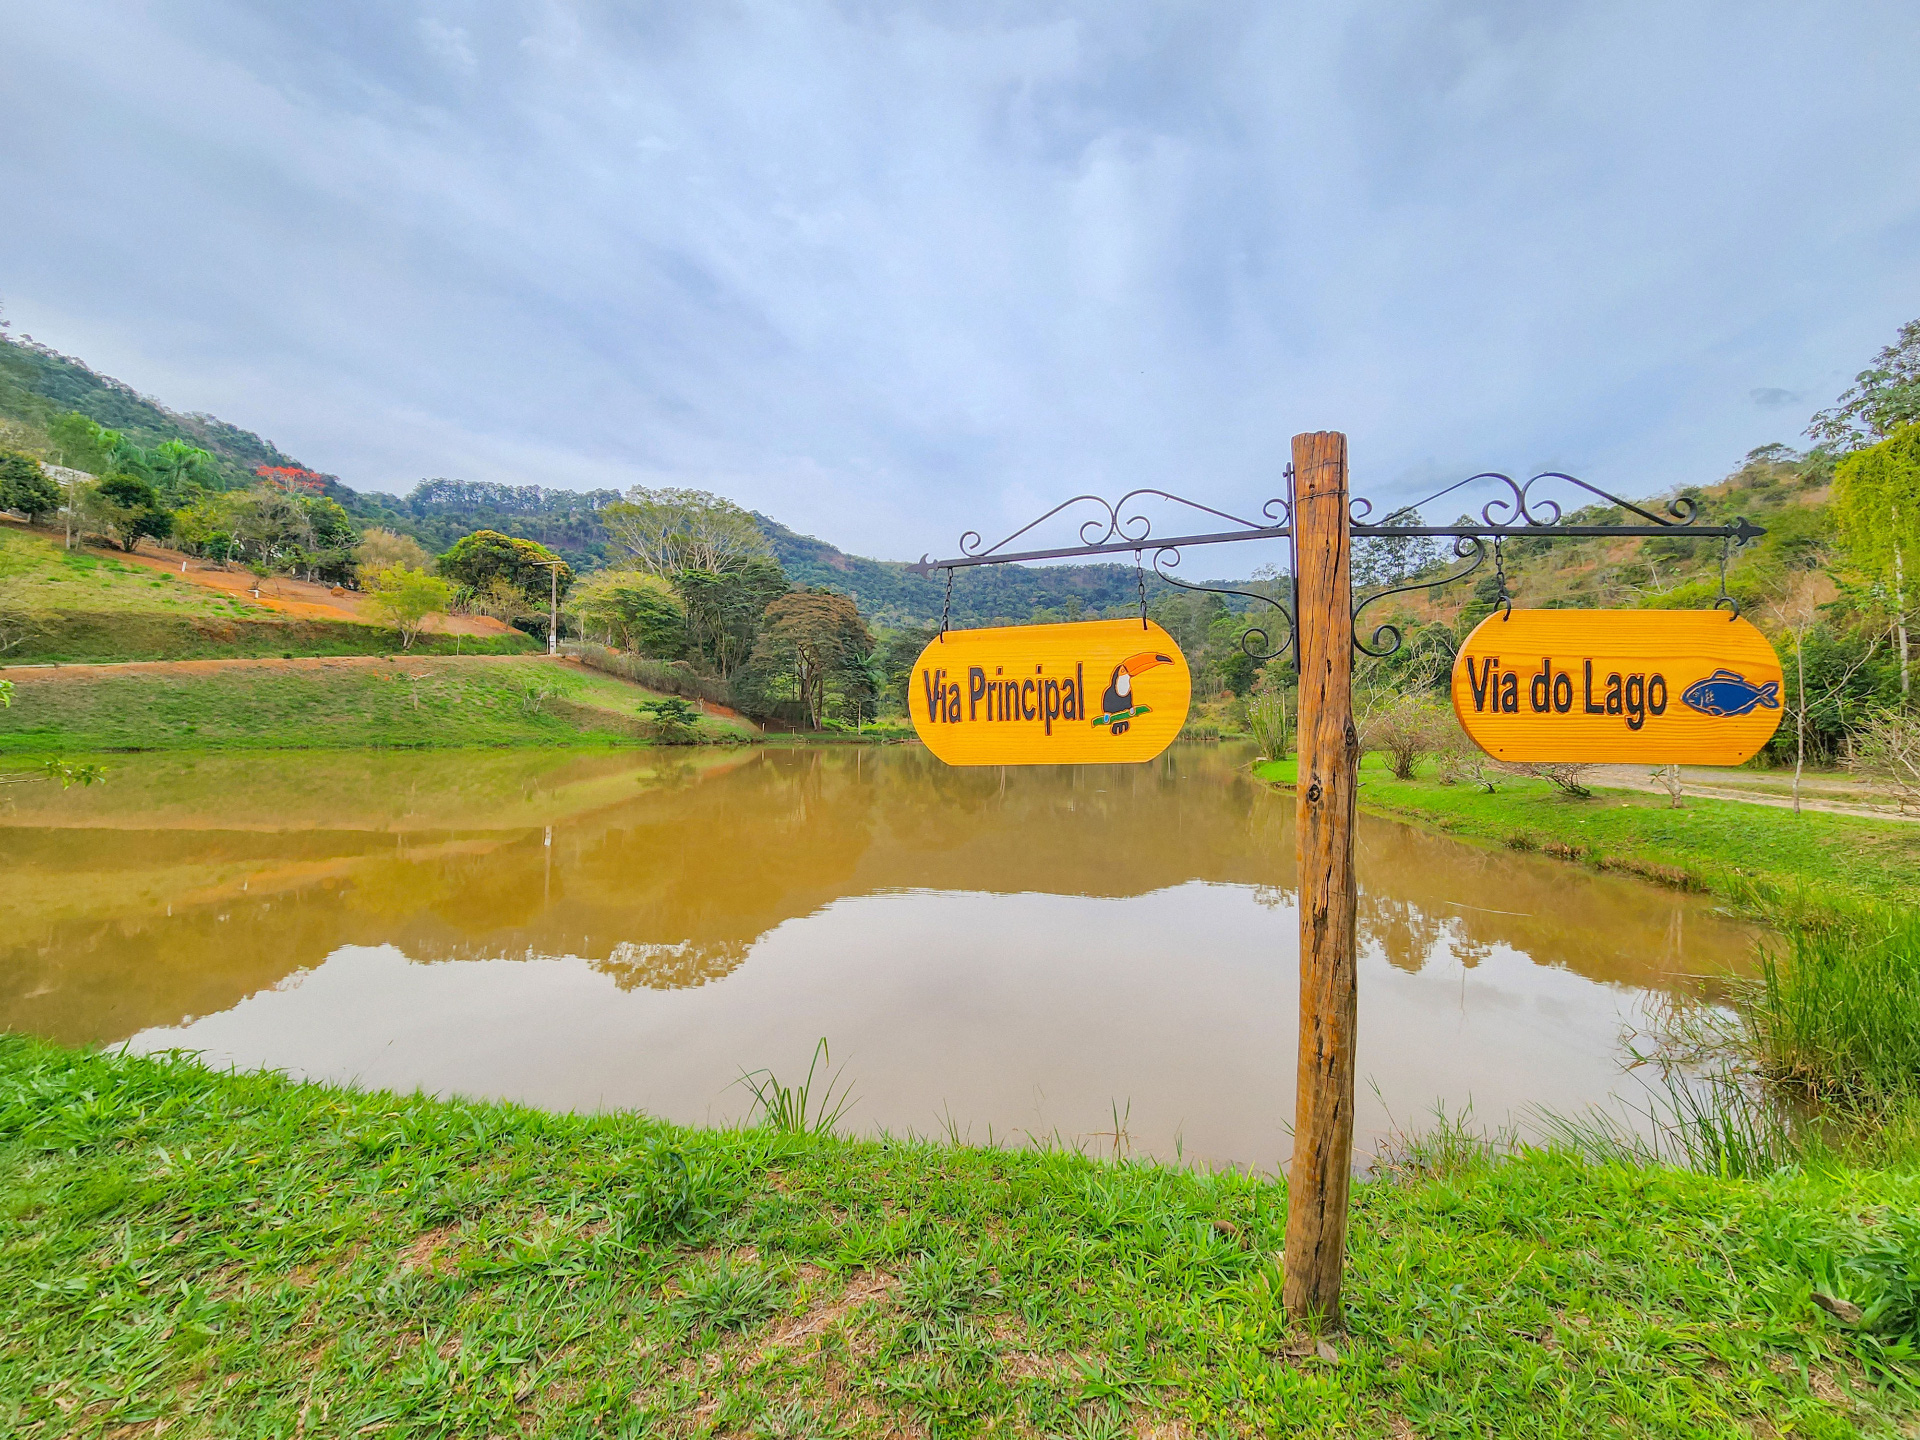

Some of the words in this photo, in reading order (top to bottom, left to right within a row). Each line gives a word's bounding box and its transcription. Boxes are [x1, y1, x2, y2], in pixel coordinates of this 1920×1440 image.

[922, 667, 962, 723] Via
[969, 661, 1085, 736] Principal
[1466, 657, 1519, 714] Via
[1531, 658, 1573, 714] do
[1584, 659, 1668, 731] Lago
